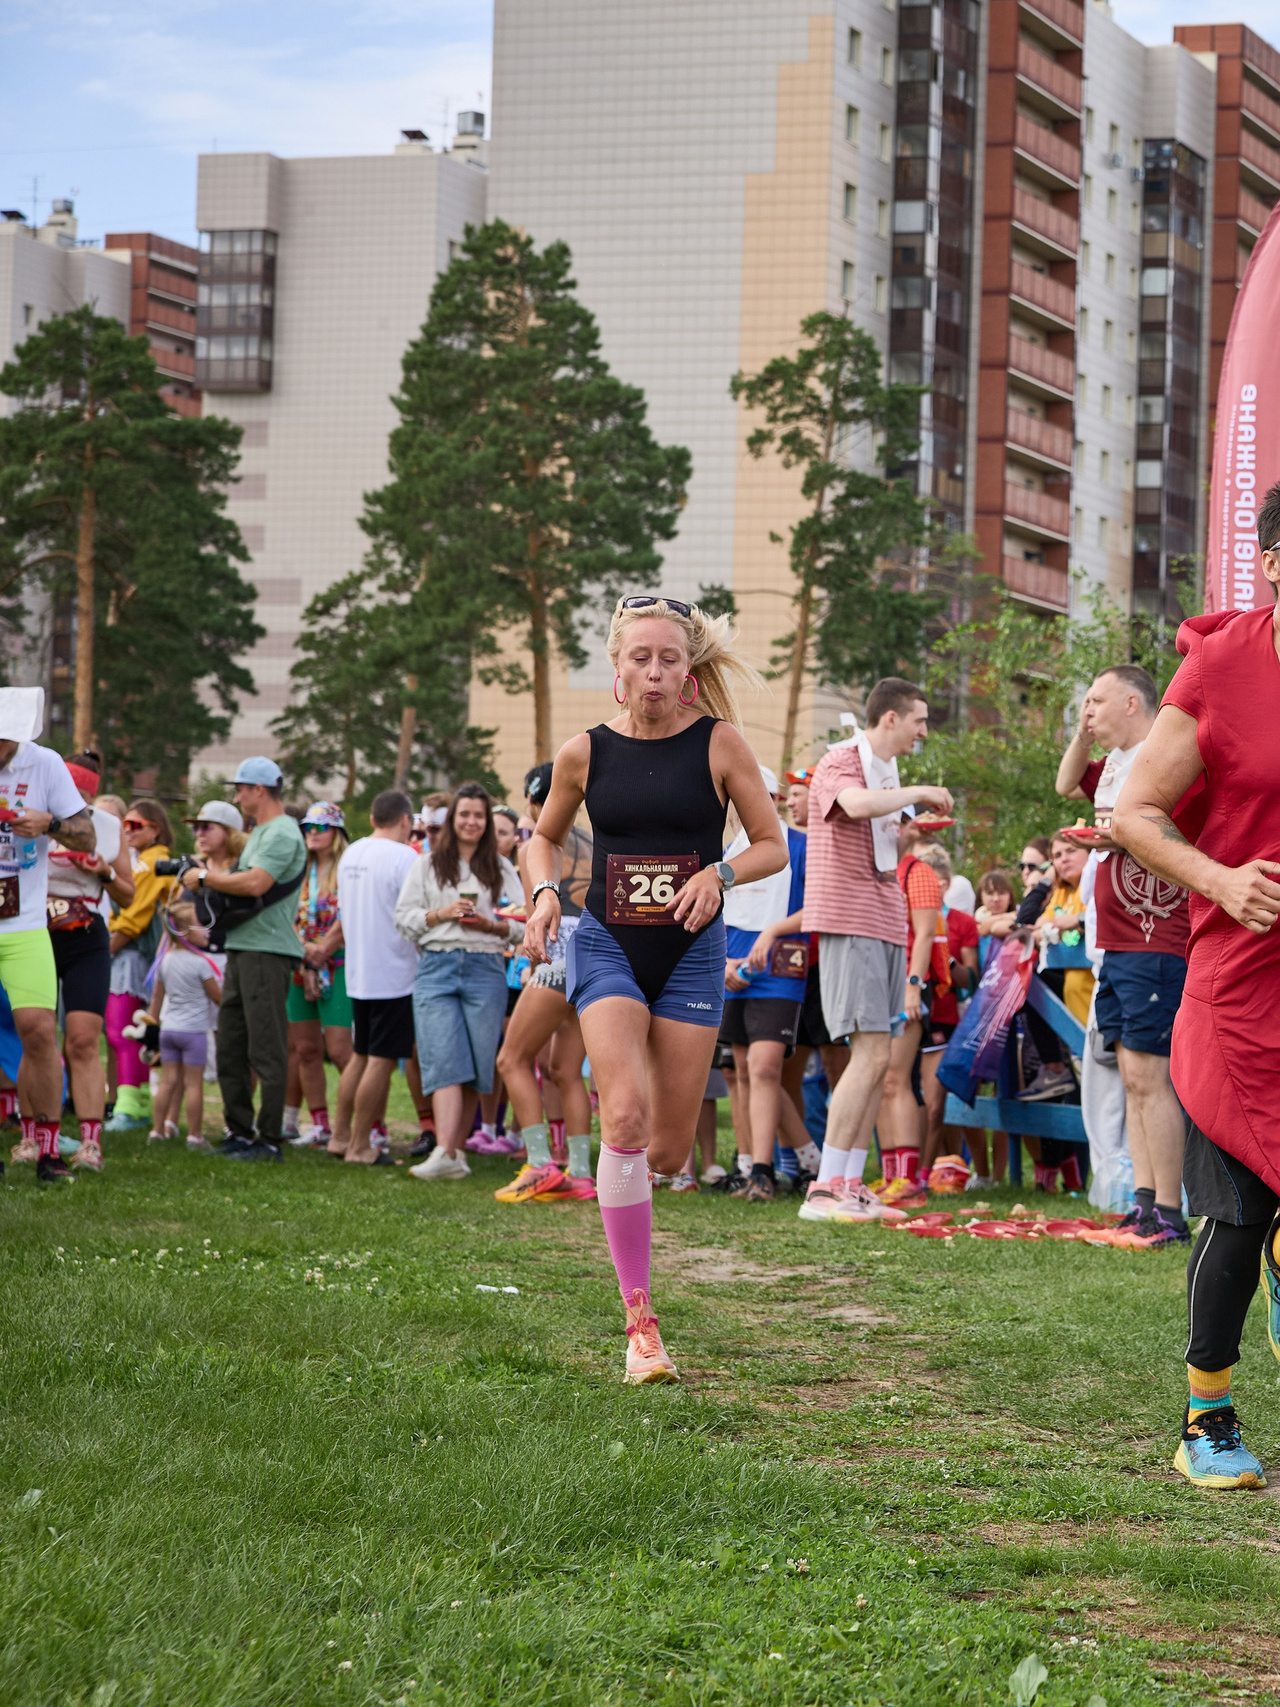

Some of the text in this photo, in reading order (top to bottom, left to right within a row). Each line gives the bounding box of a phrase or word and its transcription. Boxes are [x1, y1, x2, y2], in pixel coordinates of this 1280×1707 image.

[624, 864, 662, 873] ХИНКАЛЬНАЯ
[629, 874, 675, 904] 26
[47, 900, 70, 918] 19
[789, 950, 803, 967] 4
